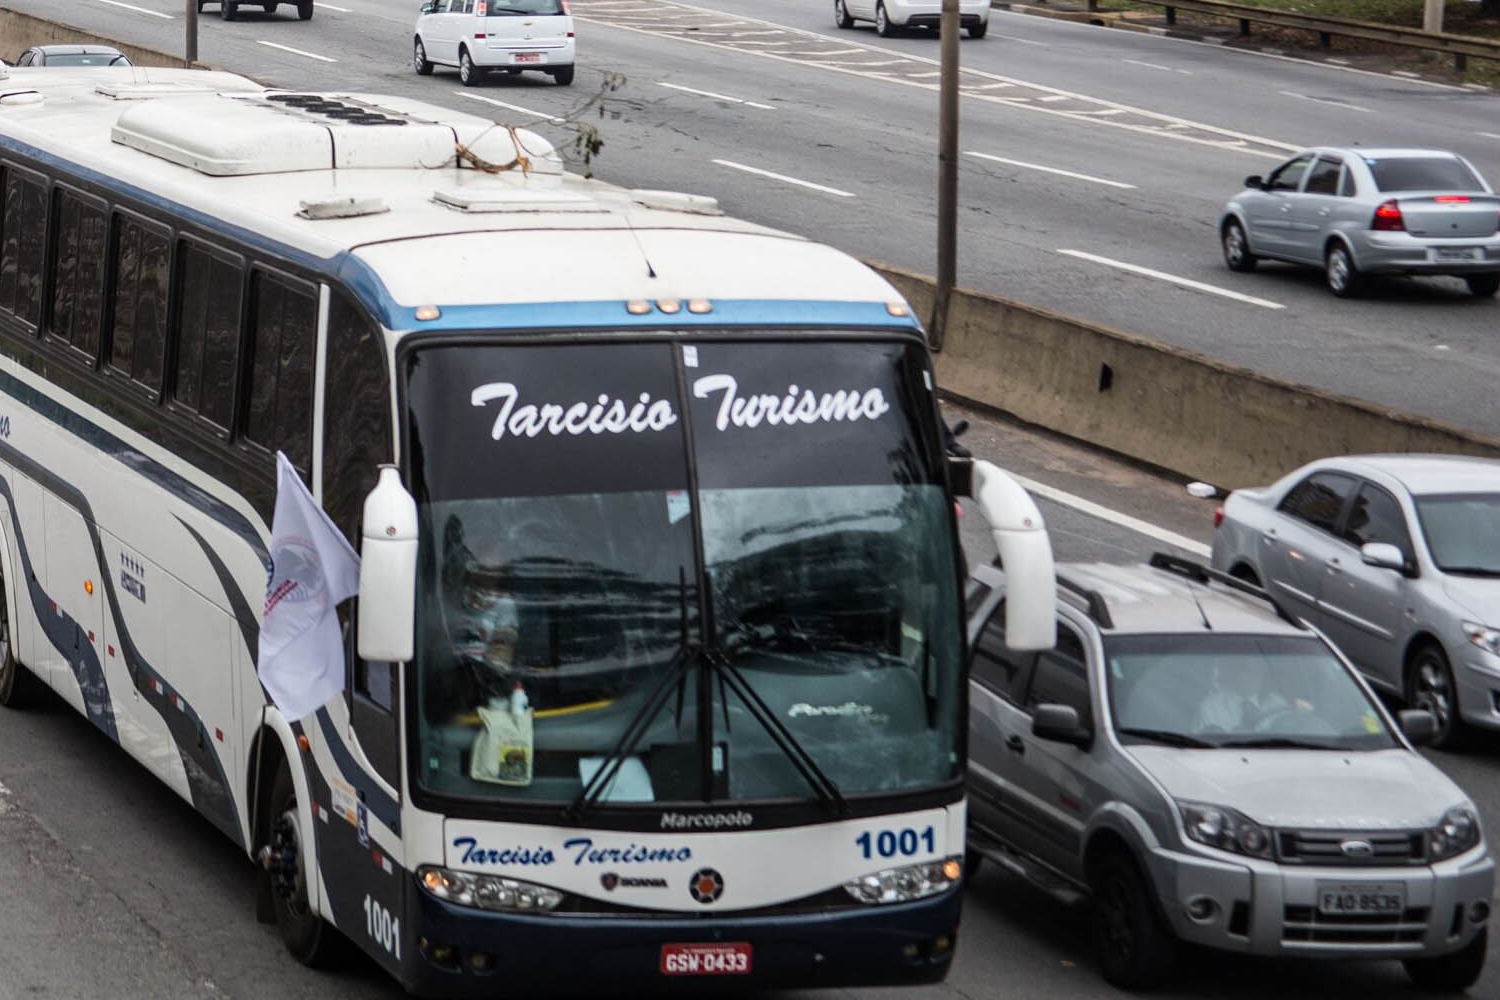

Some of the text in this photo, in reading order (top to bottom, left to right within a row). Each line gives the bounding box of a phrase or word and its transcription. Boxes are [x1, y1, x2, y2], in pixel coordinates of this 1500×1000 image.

[471, 374, 889, 440] Tarcisio Turismo
[660, 811, 752, 829] Marcopolo
[453, 837, 693, 866] Tarcisio Turismo
[855, 825, 935, 859] 1001
[364, 893, 401, 961] 1001
